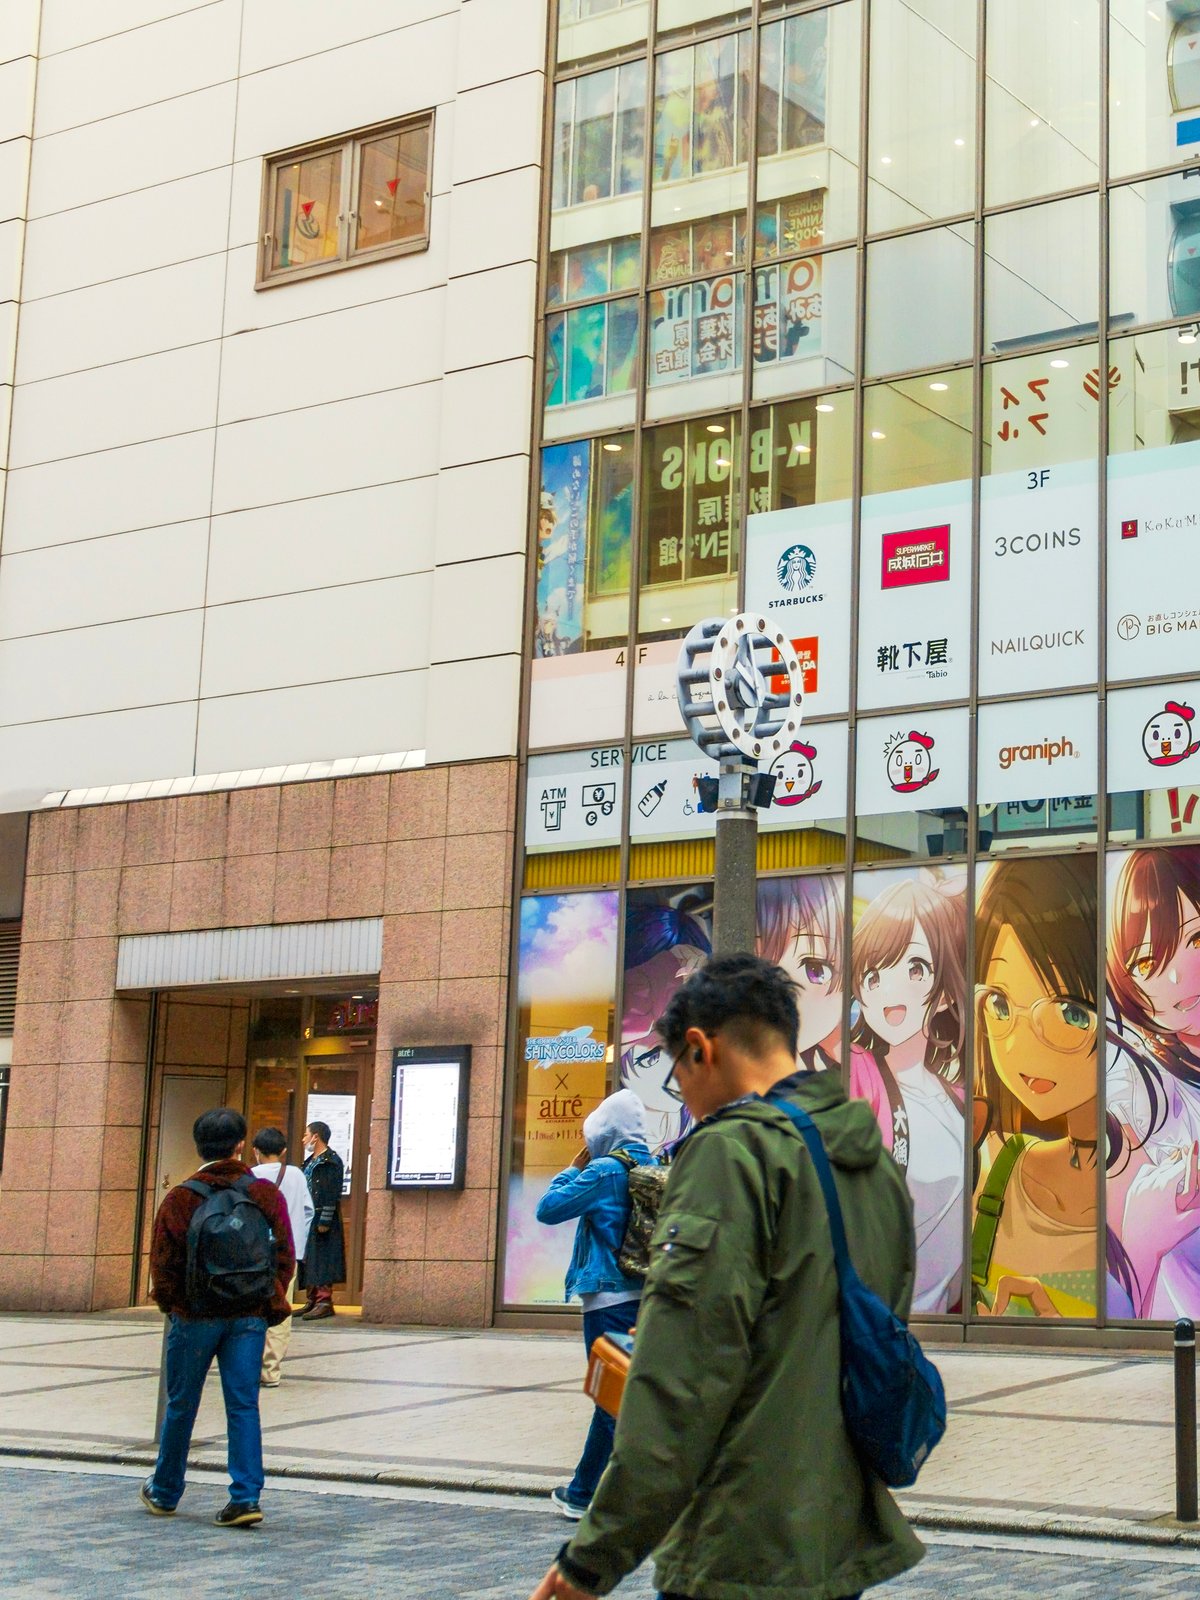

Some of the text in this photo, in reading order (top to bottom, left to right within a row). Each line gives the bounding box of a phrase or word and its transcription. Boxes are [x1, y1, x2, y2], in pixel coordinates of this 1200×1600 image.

[1027, 469, 1051, 490] 3F
[896, 542, 936, 556] SUPERMARKET
[994, 527, 1081, 557] 3COINS
[887, 550, 944, 573] 成城石井
[768, 593, 824, 609] STARBUCKS
[1146, 622, 1173, 636] BIG
[991, 629, 1085, 656] NAILQUICK
[877, 637, 948, 672] 靴下屋
[926, 669, 948, 679] Tabio
[590, 743, 667, 768] SERVICE
[999, 736, 1073, 770] graniph
[541, 786, 568, 800] ATM
[525, 1043, 605, 1061] SHINYCOLORS
[539, 1094, 583, 1118] atré
